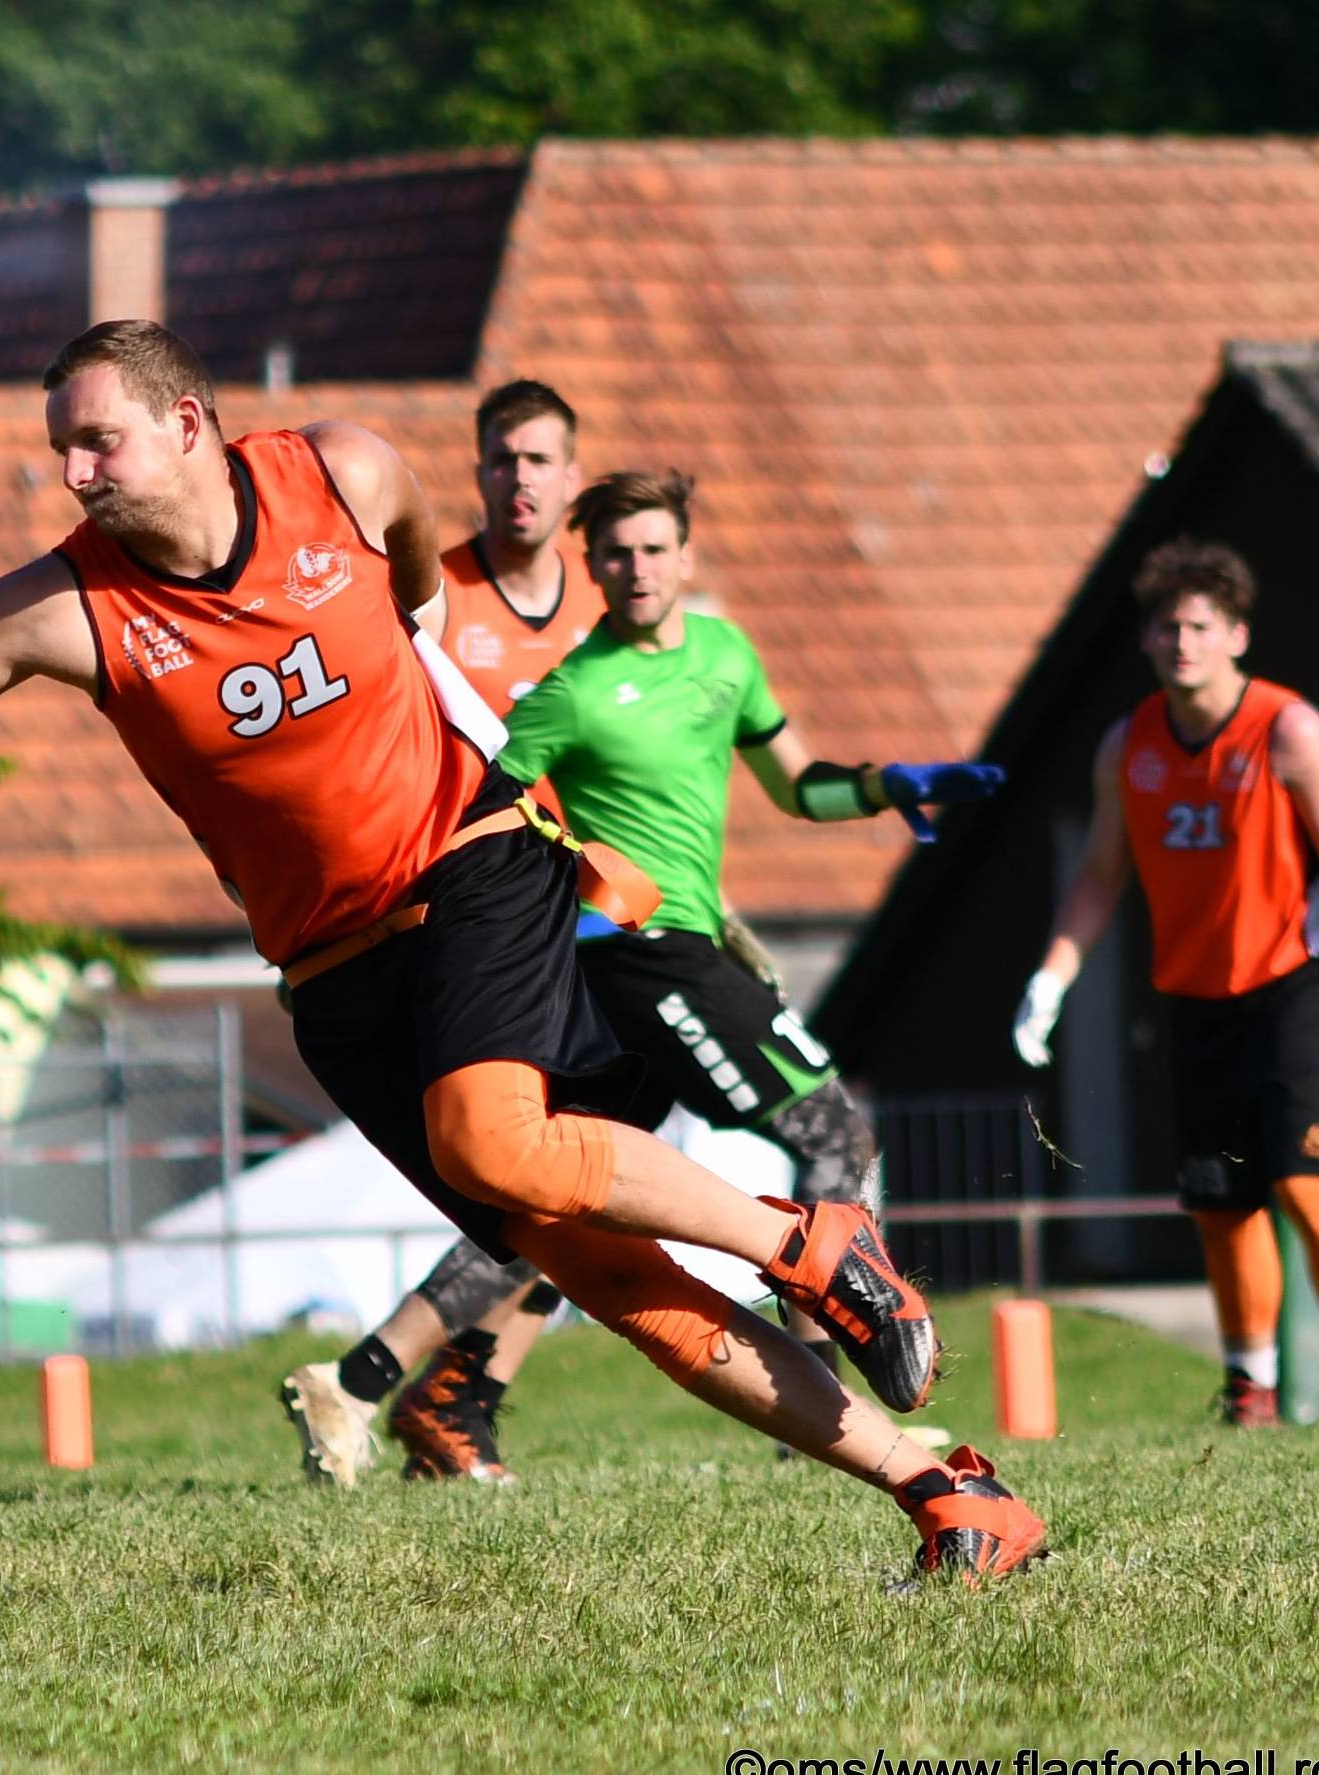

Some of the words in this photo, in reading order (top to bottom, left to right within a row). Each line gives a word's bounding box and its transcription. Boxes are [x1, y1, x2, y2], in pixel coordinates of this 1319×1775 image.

[138, 620, 181, 647] FLAG
[150, 651, 194, 678] BALL
[217, 632, 351, 739] 91
[1163, 803, 1225, 850] 21
